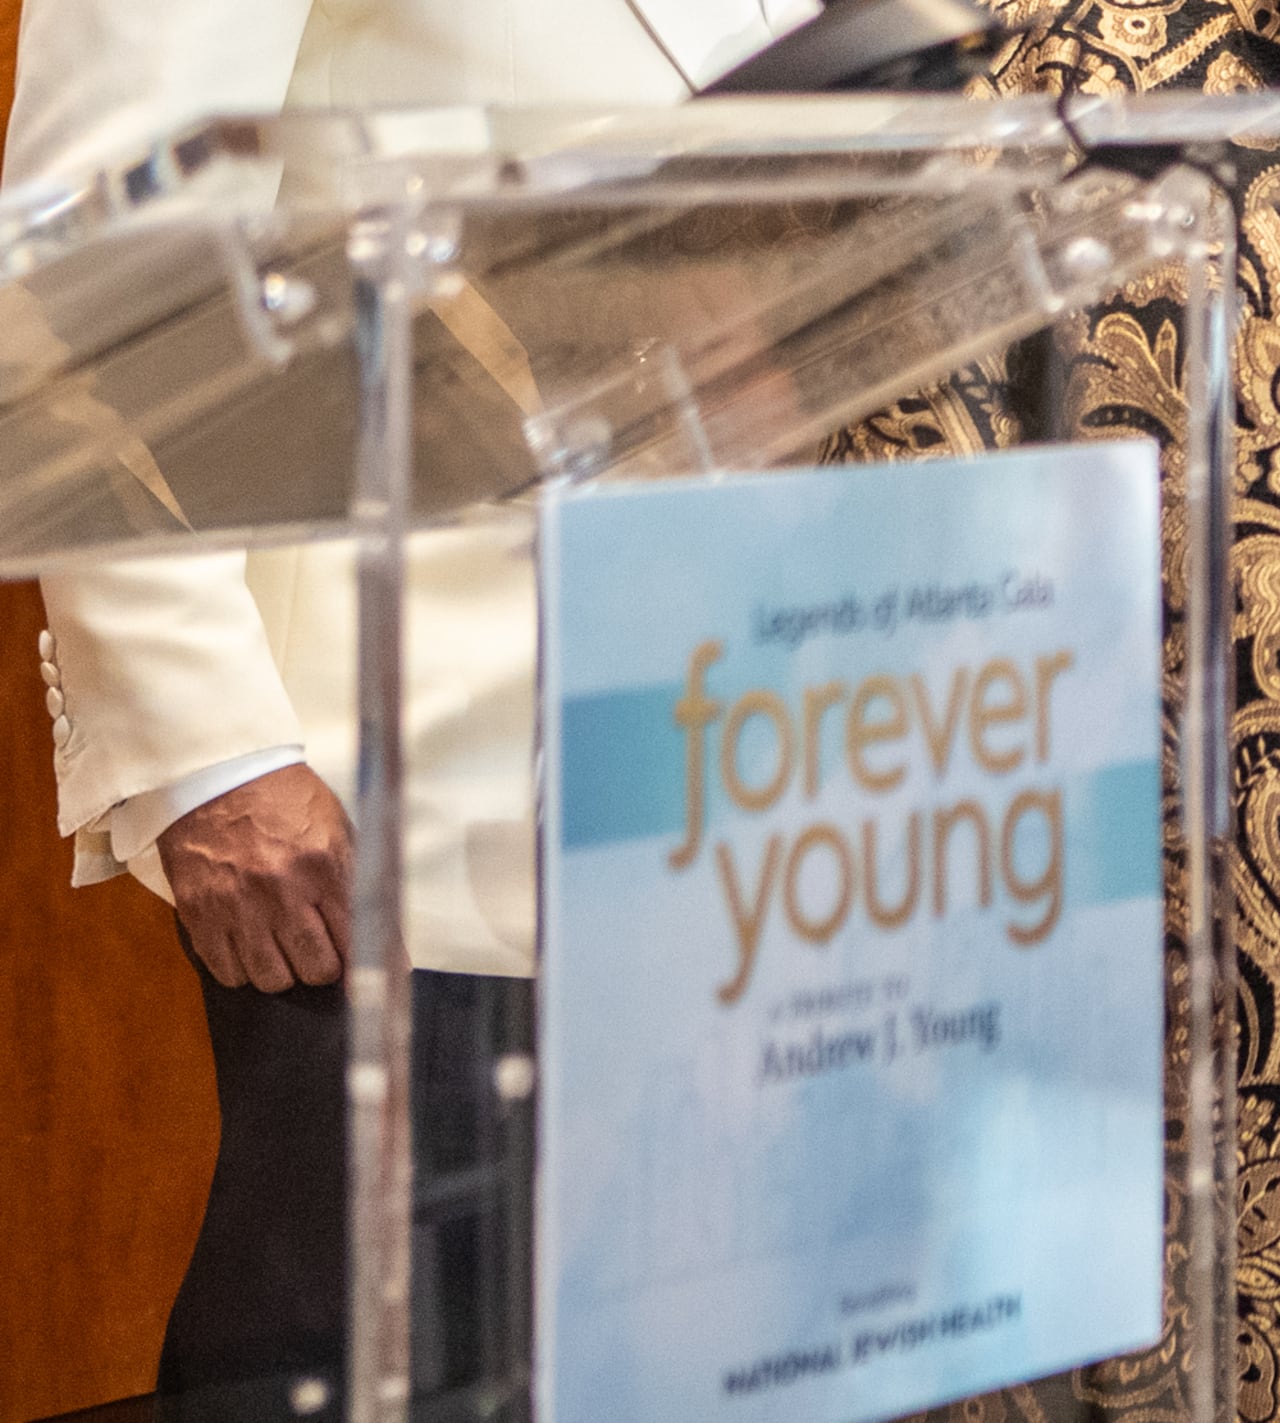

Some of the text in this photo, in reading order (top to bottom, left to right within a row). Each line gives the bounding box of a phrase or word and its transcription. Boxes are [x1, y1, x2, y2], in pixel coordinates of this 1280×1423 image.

[667, 638, 1074, 872] forever
[714, 784, 1064, 1005] young
[912, 1000, 1000, 1054] Young
